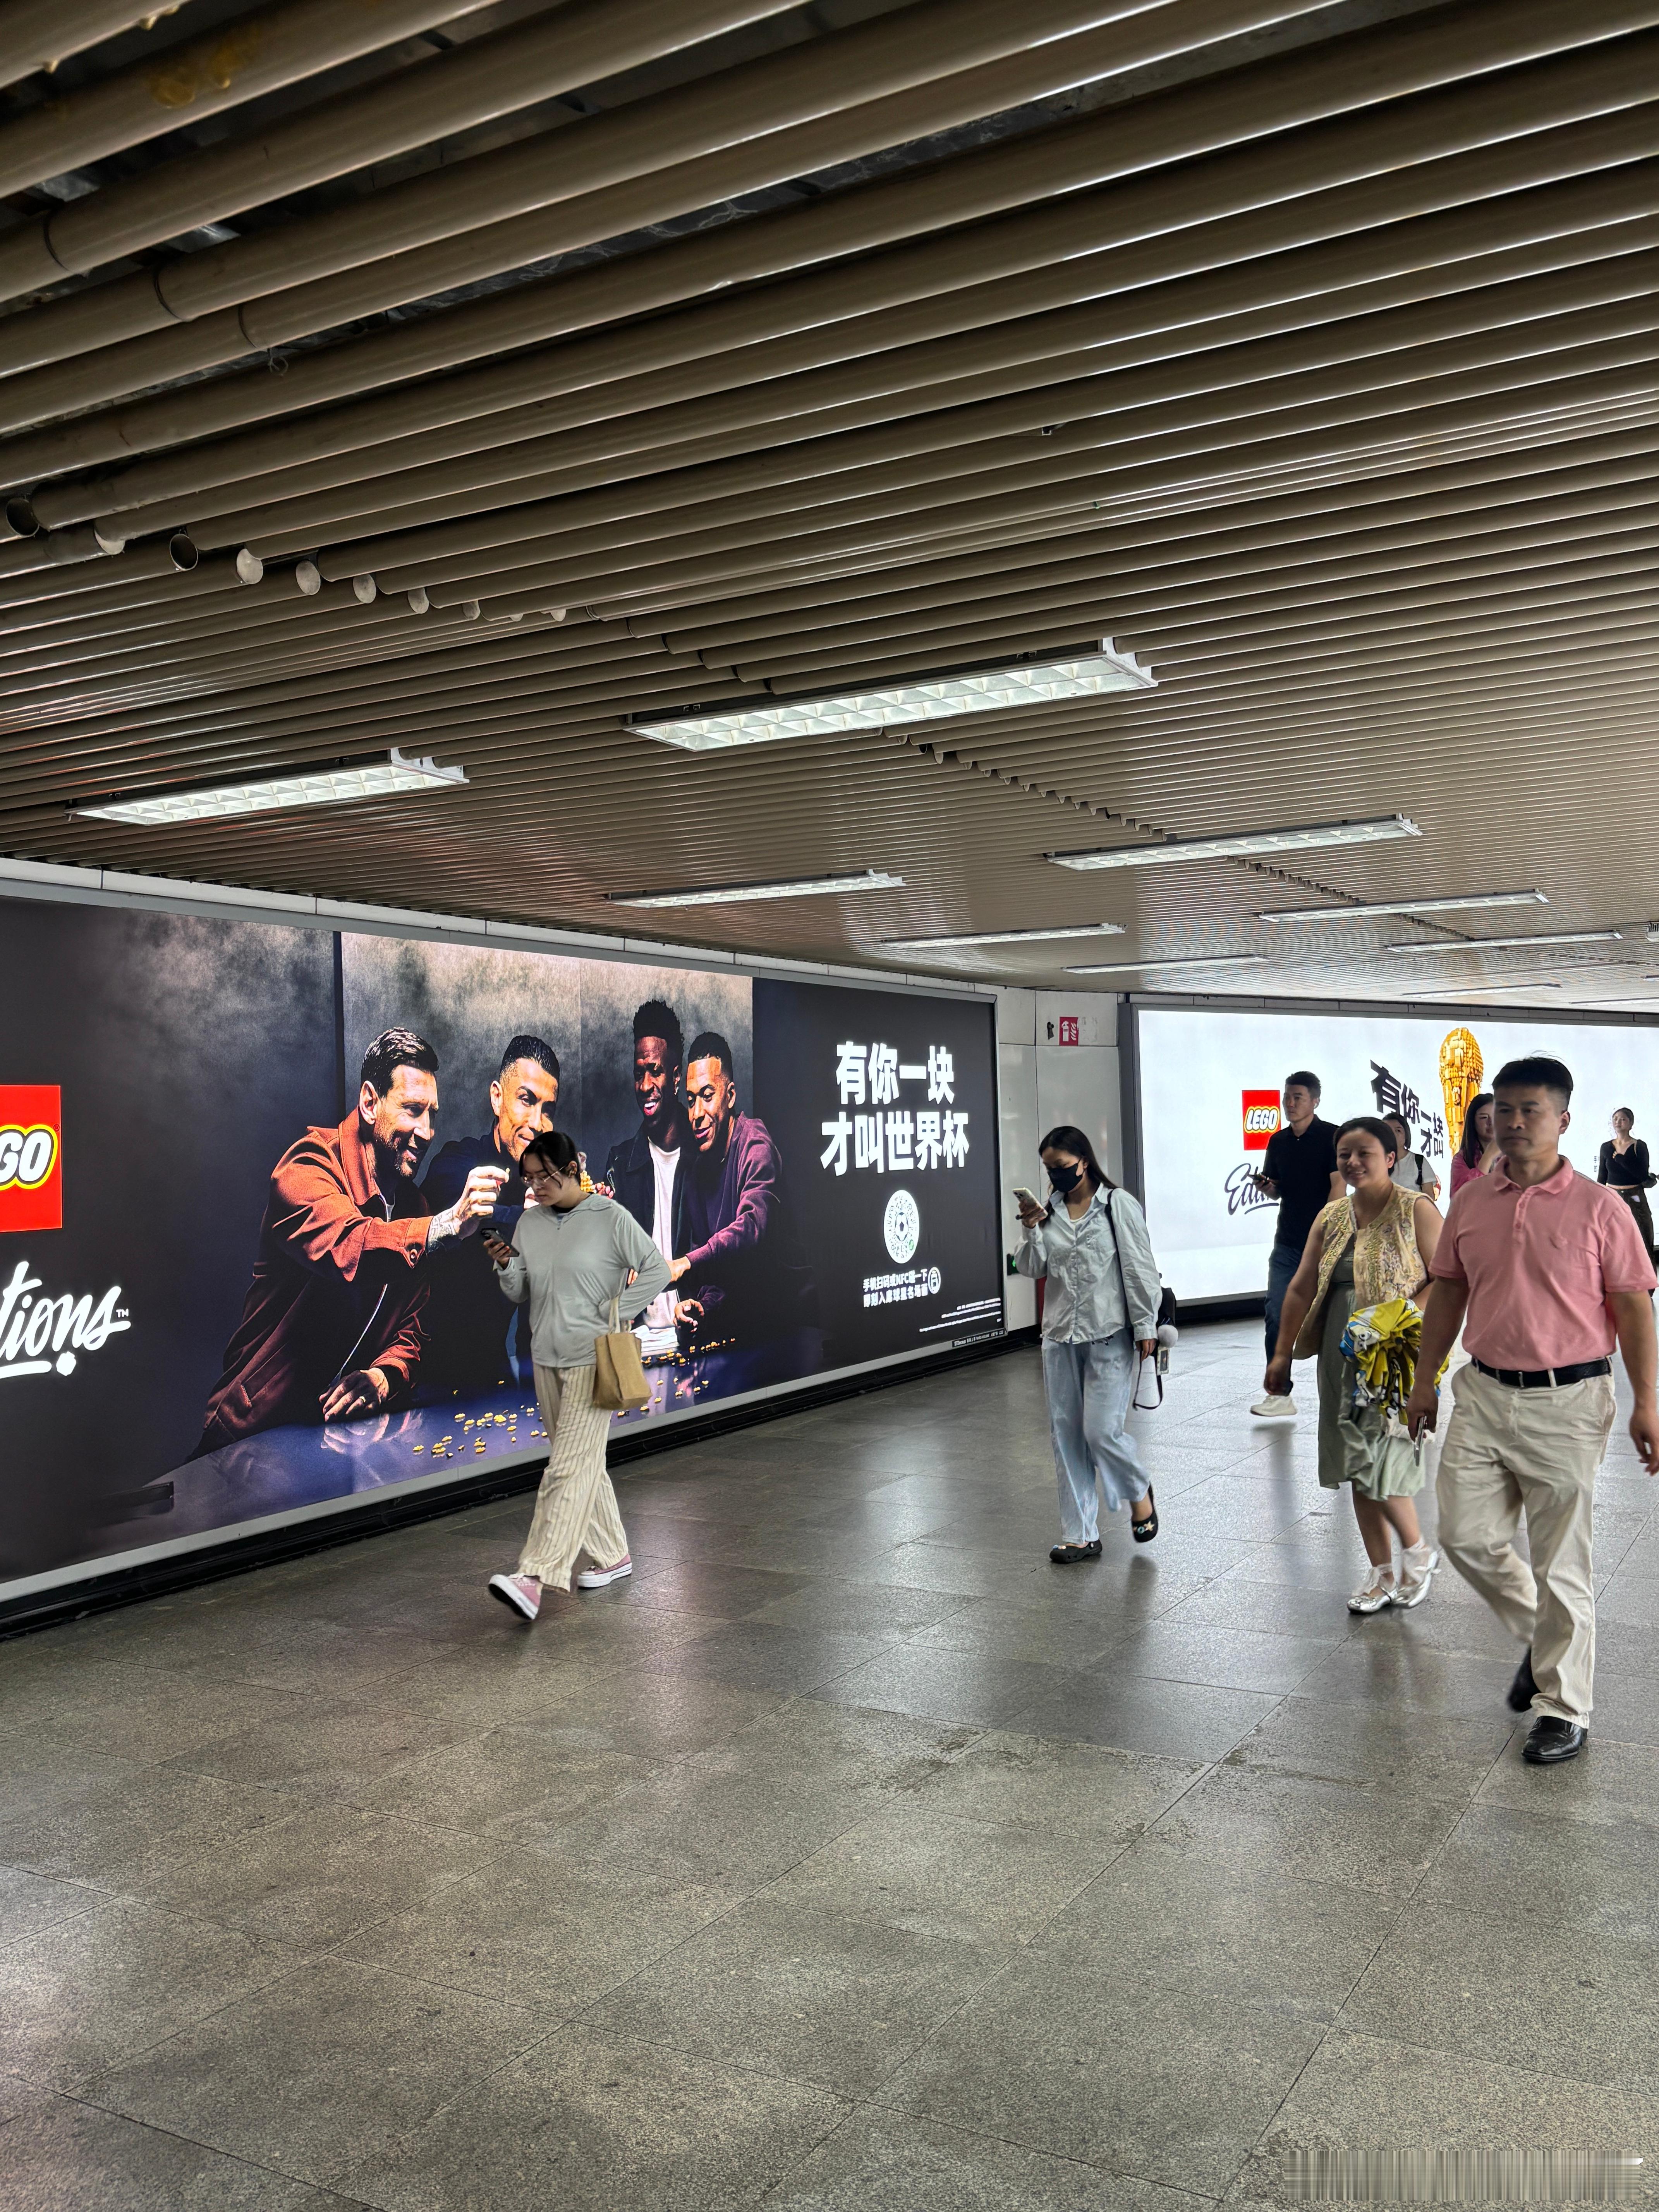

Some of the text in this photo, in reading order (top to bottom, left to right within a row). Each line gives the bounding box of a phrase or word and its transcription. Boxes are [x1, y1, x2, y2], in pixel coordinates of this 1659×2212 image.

[836, 1041, 955, 1105] 有你一块
[1370, 1059, 1443, 1138] 有你一块
[820, 1110, 970, 1176] 才叫世界杯
[1245, 1108, 1279, 1131] LEGO
